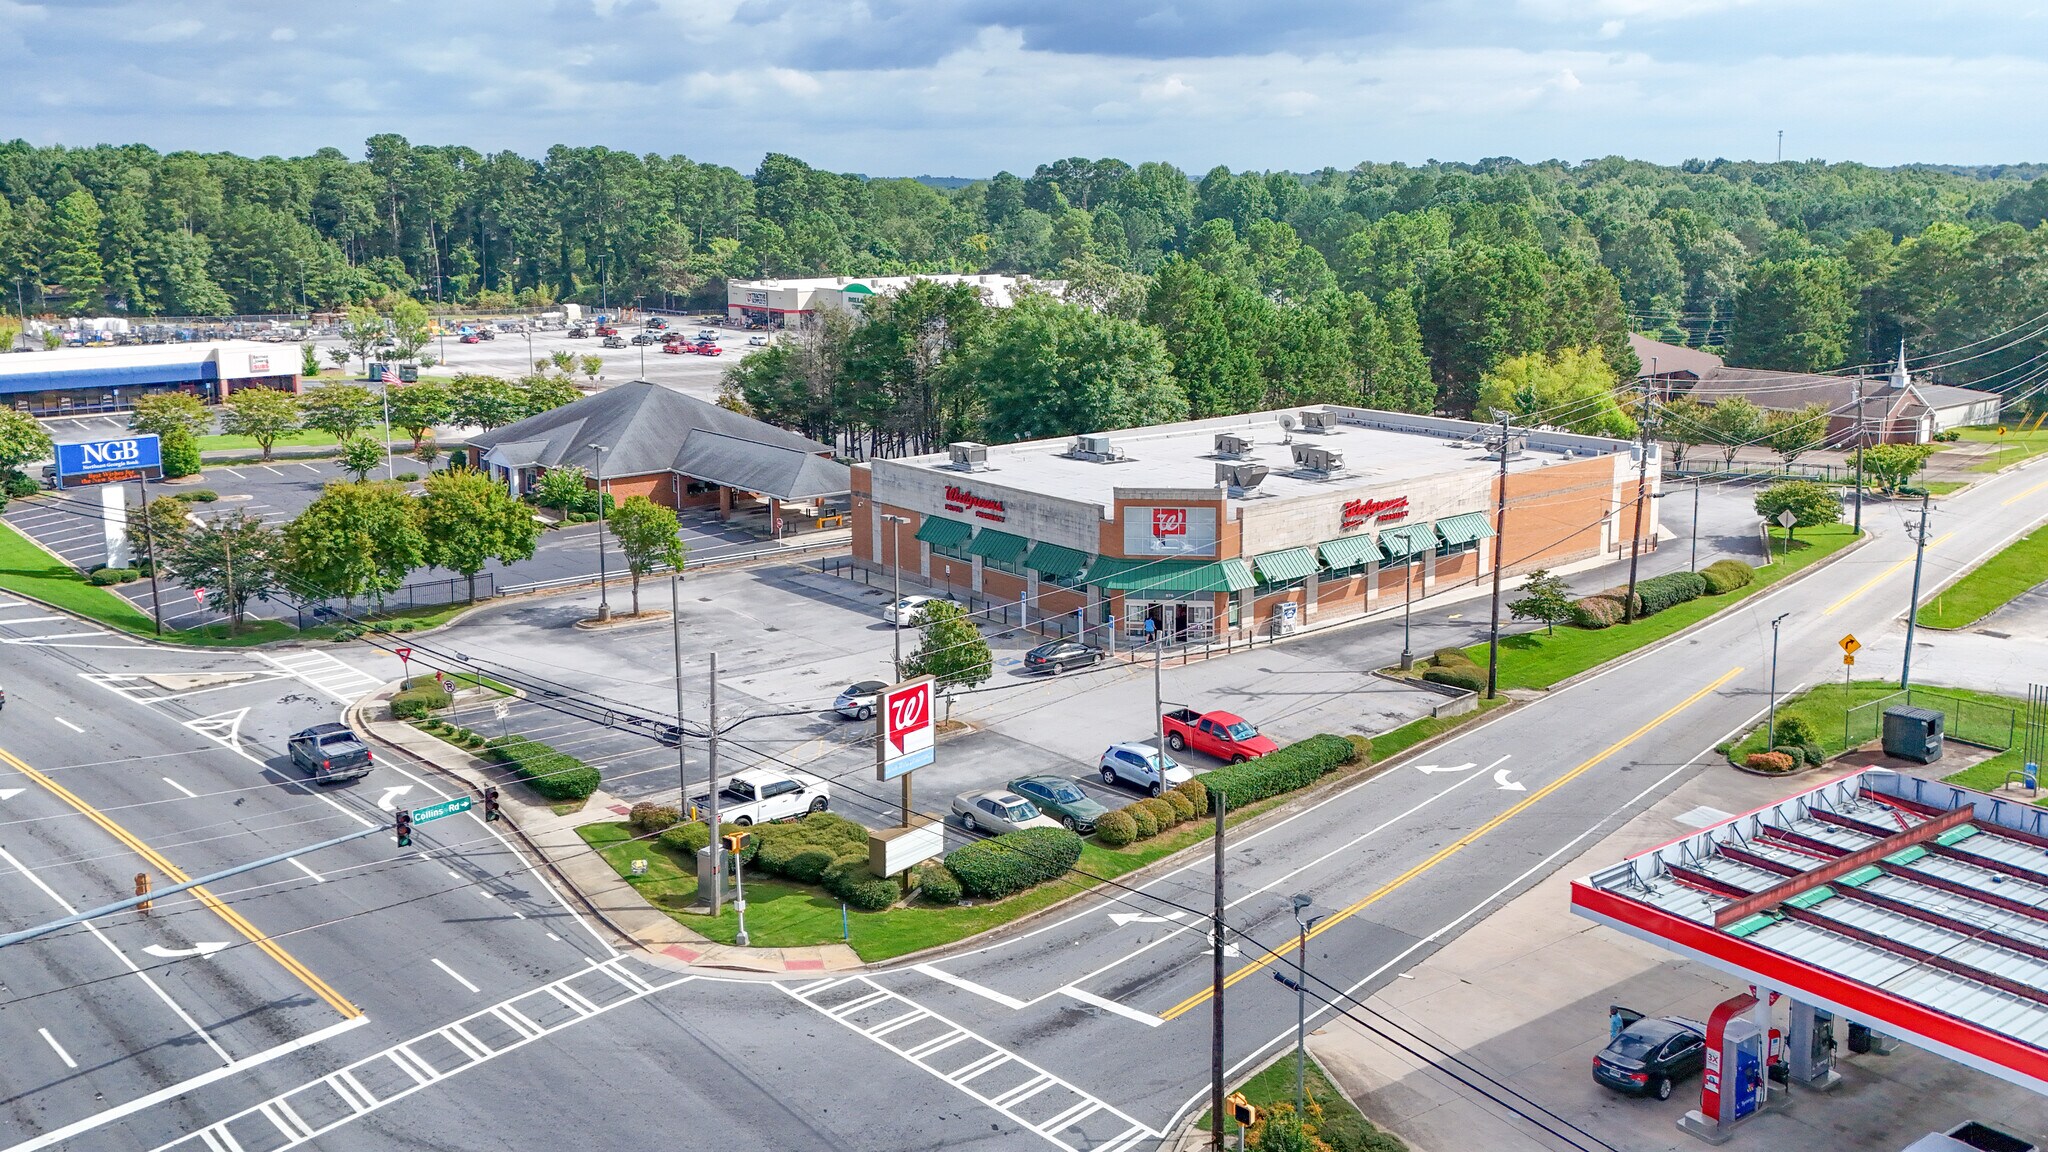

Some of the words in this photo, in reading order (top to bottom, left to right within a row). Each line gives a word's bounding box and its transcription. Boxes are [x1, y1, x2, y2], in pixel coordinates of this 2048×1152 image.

[81, 440, 139, 464] NGB
[945, 485, 1005, 512] Walgreens
[1343, 495, 1410, 519] Walgreens
[414, 808, 444, 821] Collins
[448, 802, 460, 813] Rd
